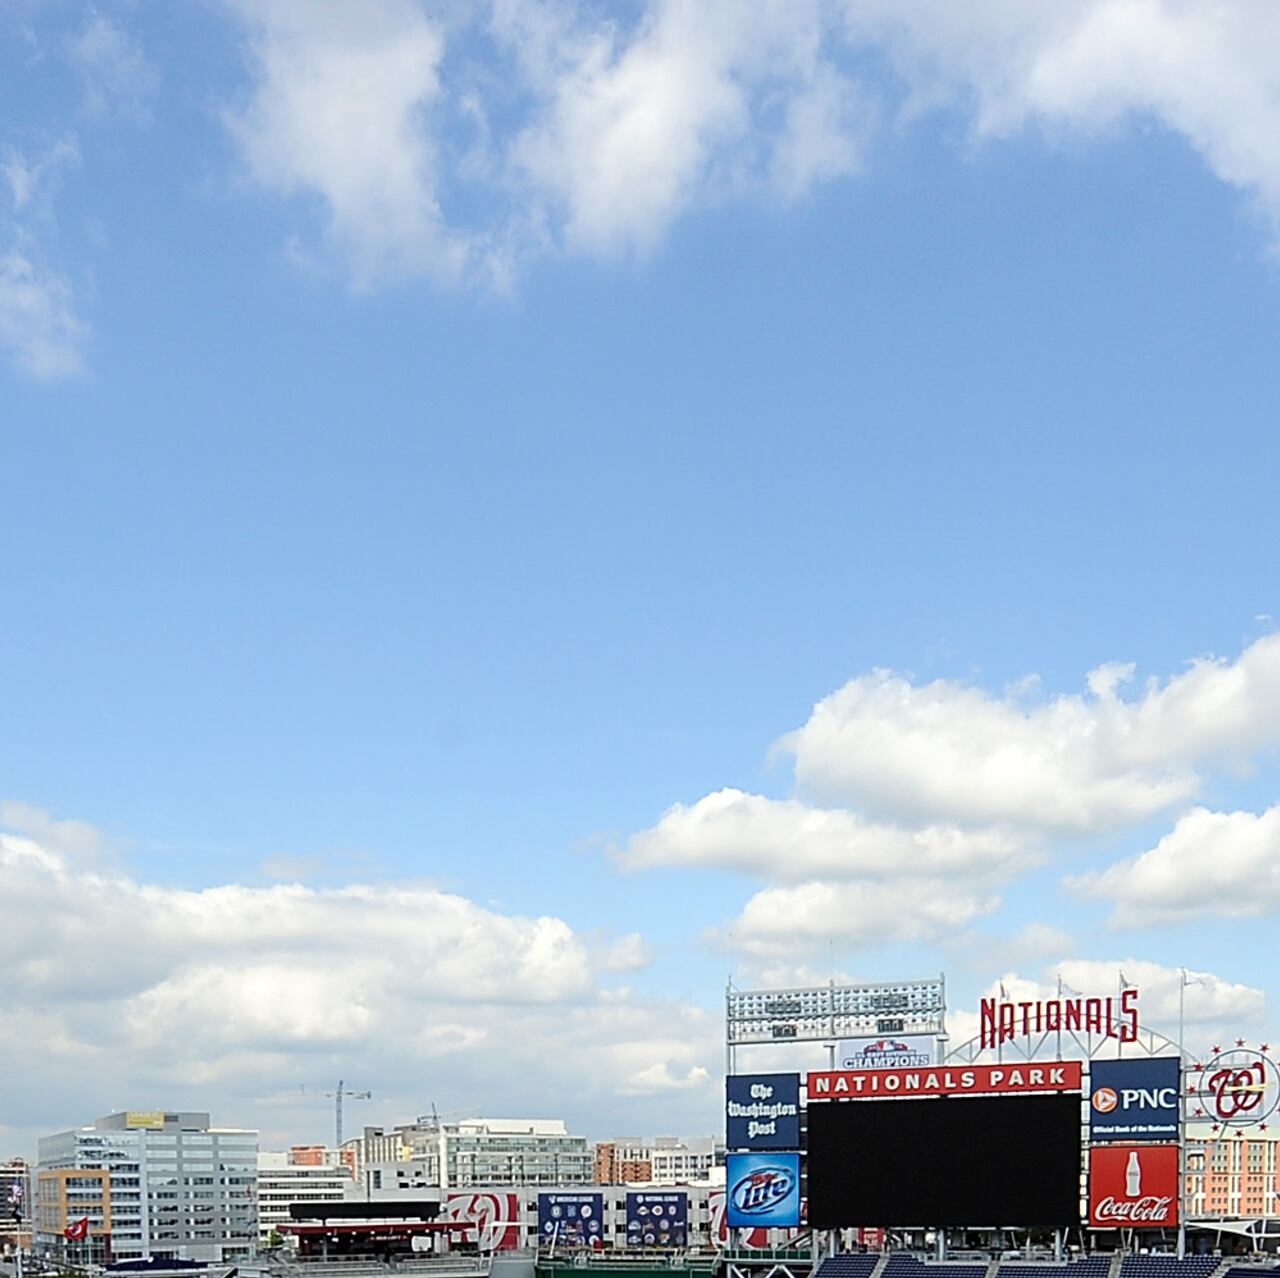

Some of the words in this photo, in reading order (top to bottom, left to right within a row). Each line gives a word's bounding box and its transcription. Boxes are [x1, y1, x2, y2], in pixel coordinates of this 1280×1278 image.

[980, 990, 1138, 1049] NATIONALS
[843, 1054, 930, 1069] CHAMPIONS
[815, 1071, 976, 1093] NATIONALS
[989, 1068, 1066, 1087] PARK
[750, 1083, 773, 1100] The
[1120, 1087, 1177, 1109] PNC
[727, 1101, 797, 1119] Washington
[747, 1120, 776, 1139] Post
[1115, 1125, 1130, 1133] Bank
[740, 1178, 788, 1211] Lite
[1094, 1196, 1174, 1221] Coca-Cola
